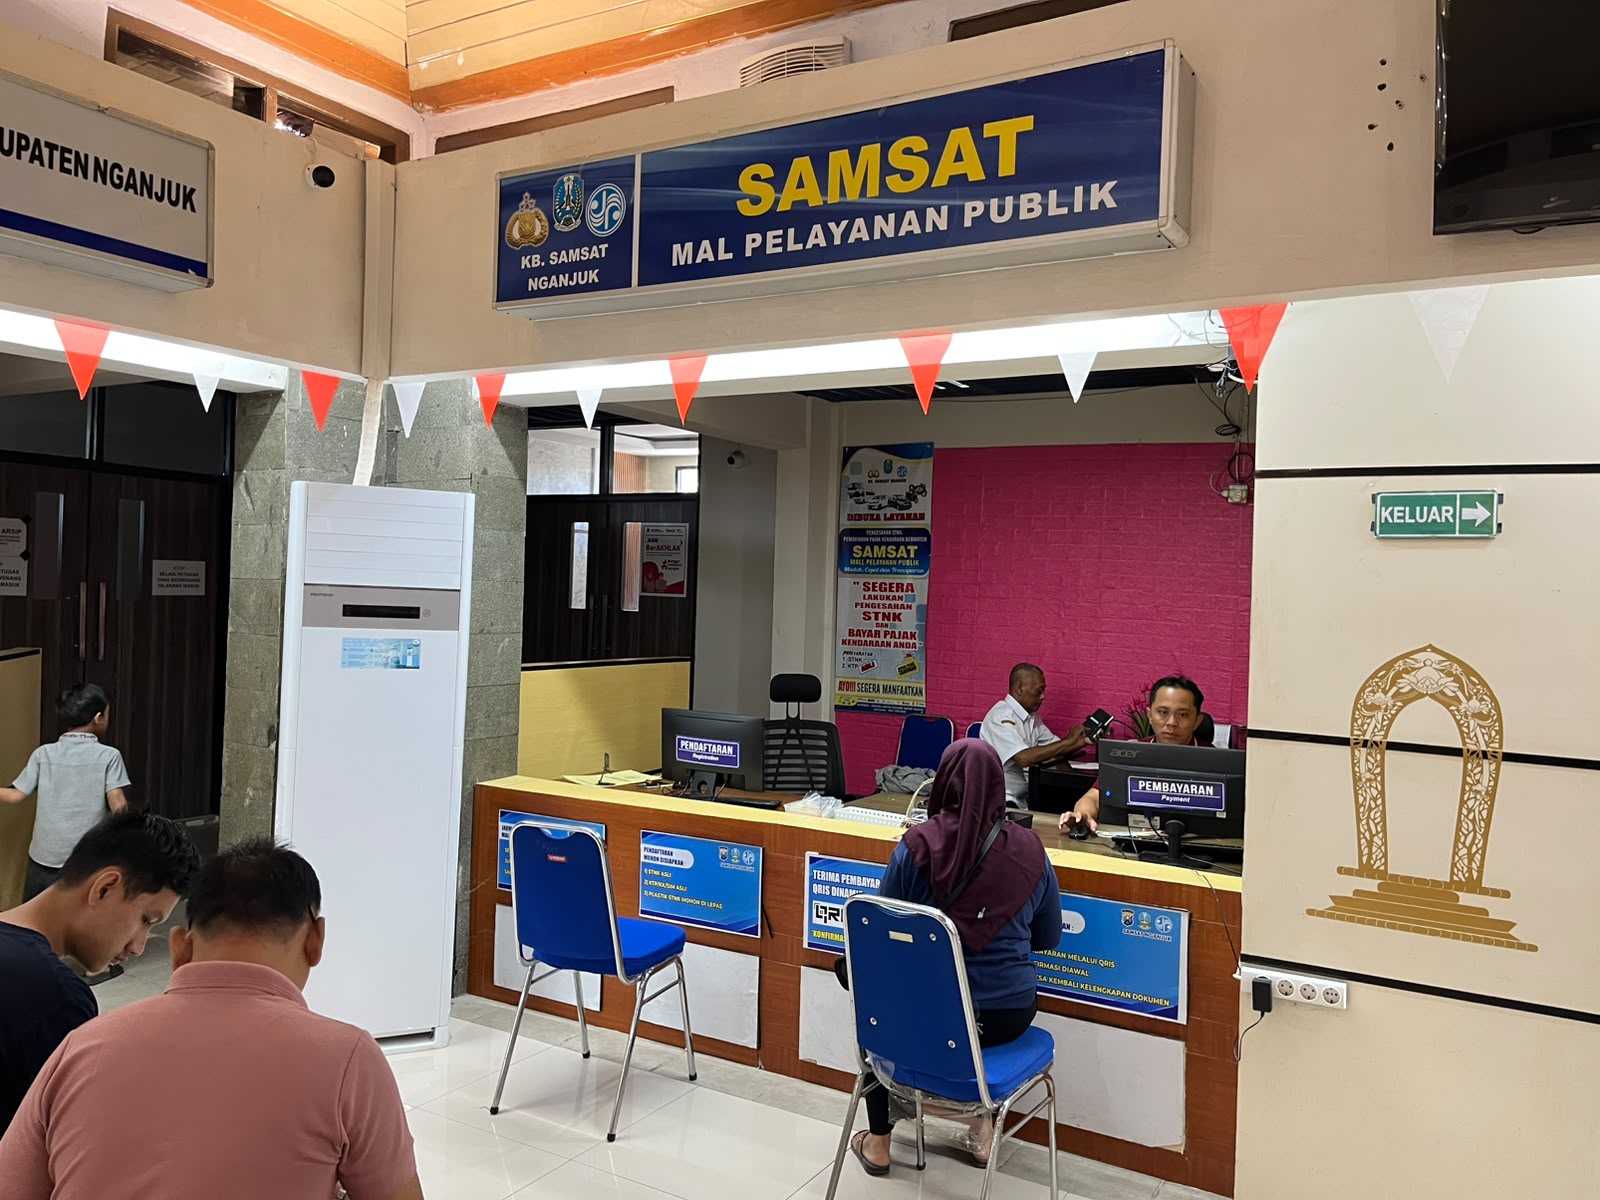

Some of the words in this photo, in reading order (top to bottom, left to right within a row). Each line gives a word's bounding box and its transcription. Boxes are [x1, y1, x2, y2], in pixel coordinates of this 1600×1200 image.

[736, 115, 1034, 217] SAMSAT
[93, 156, 196, 213] NGANJUK
[671, 238, 734, 267] MAL
[745, 205, 949, 257] PELAYANAN
[964, 180, 1121, 227] PUBLIK
[521, 254, 545, 269] KB.
[549, 244, 608, 265] SAMSAT
[528, 269, 599, 291] NGANJUK
[884, 513, 925, 521] LAYANAN
[1381, 506, 1454, 523] KELUAR
[853, 545, 918, 558] SAMSAT
[862, 581, 914, 593] SEGERA
[854, 602, 912, 610] PENGESAHAN
[862, 611, 902, 622] STNK
[848, 629, 880, 639] BAYAR
[883, 630, 917, 640] PAJAK
[841, 639, 891, 648] KENDARAAN
[838, 681, 856, 692] AYO!!!
[857, 683, 881, 694] SEGERA
[882, 684, 924, 697] MANFAATKAN
[680, 740, 733, 755] PENDAFTARAN
[1110, 749, 1140, 758] acer
[1138, 780, 1214, 796] PEMBAYARAN
[1161, 795, 1191, 803] Payment
[643, 846, 673, 856] PENDAFTARAN
[813, 869, 840, 884] TERIMA
[813, 883, 830, 896] QRIS
[648, 891, 668, 899] PLASTIK
[668, 894, 681, 902] STNK
[707, 901, 723, 909] LEPAS
[1123, 929, 1143, 937] SAMSAT
[1144, 932, 1172, 941] NGANJUK
[1068, 952, 1098, 964] MELALUI
[1099, 959, 1116, 968] QRIS
[1062, 966, 1089, 977] DIAWAL
[1049, 977, 1079, 988] KEMBALI
[1080, 983, 1131, 999] KELENGKAPAN
[1132, 993, 1170, 1007] DOKUMEN
